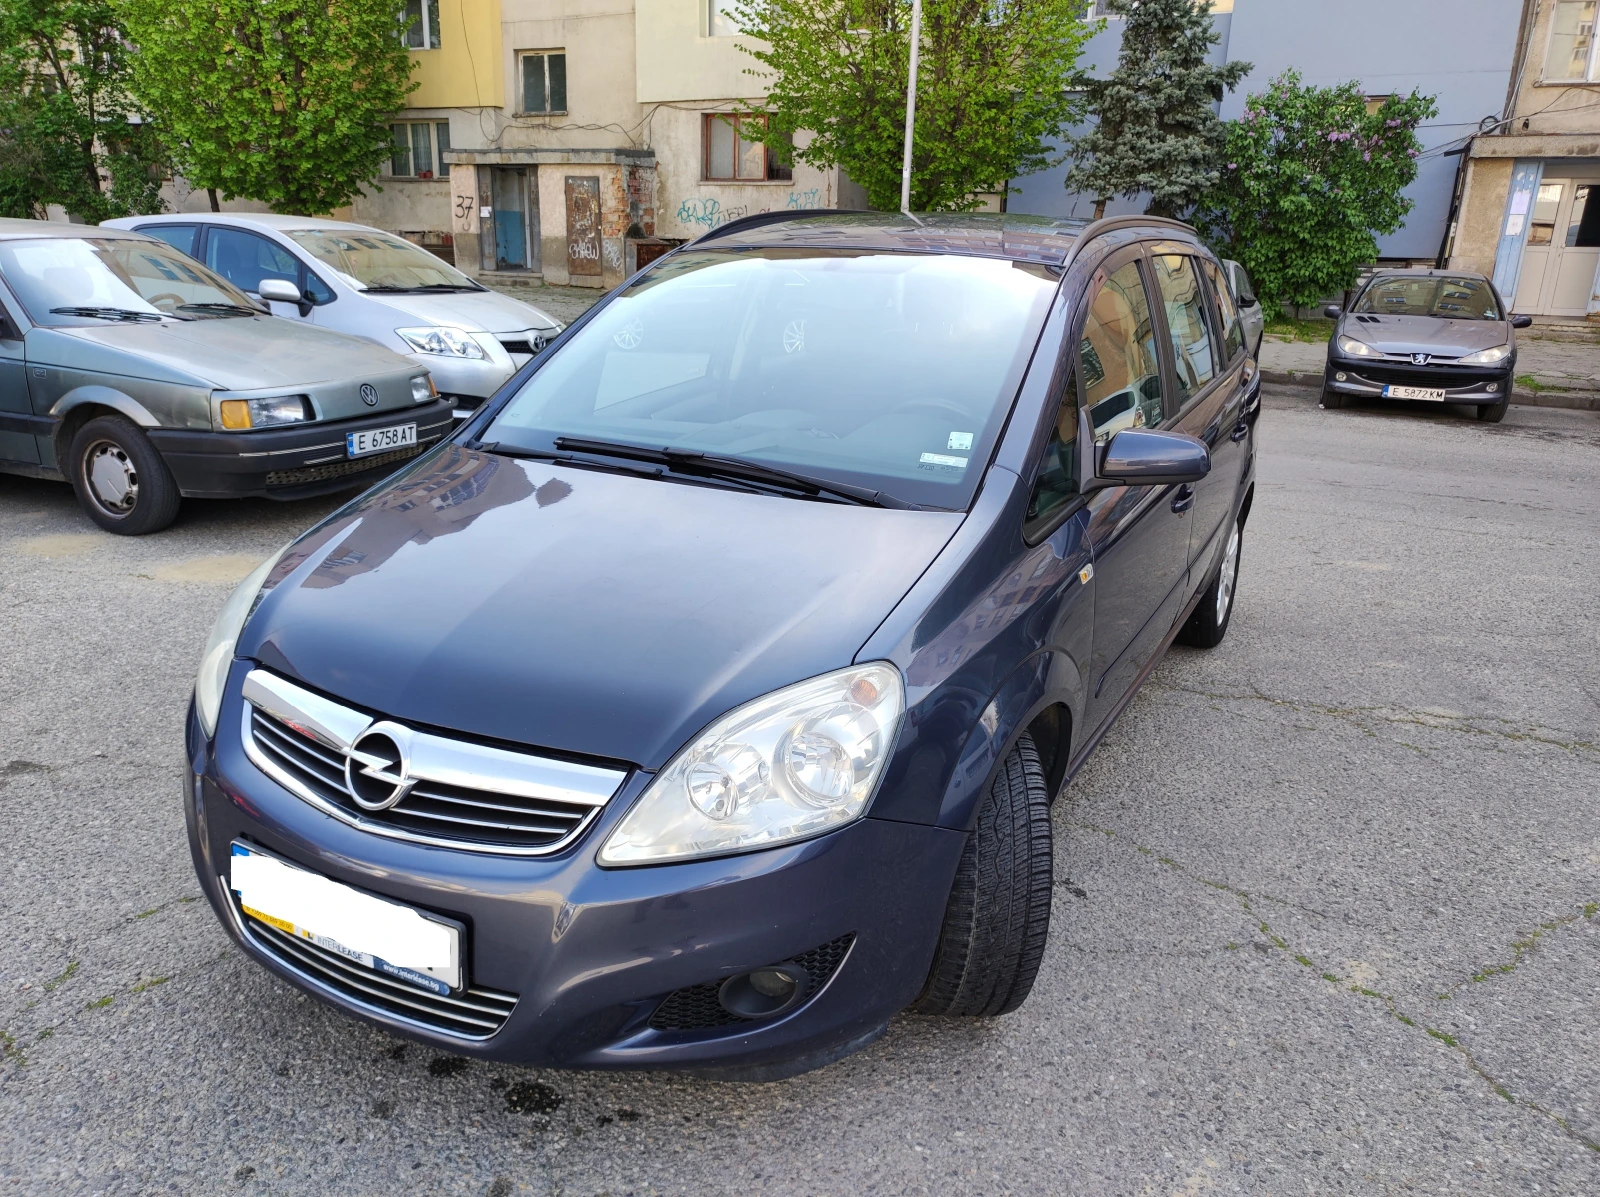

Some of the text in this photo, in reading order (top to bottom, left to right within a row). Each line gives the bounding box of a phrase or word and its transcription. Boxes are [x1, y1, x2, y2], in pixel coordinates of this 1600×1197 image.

[455, 195, 474, 220] 37
[1392, 387, 1400, 397] E
[358, 434, 366, 451] E
[317, 936, 364, 962] INTERLEASE
[382, 963, 440, 992] www.interlease.bg
